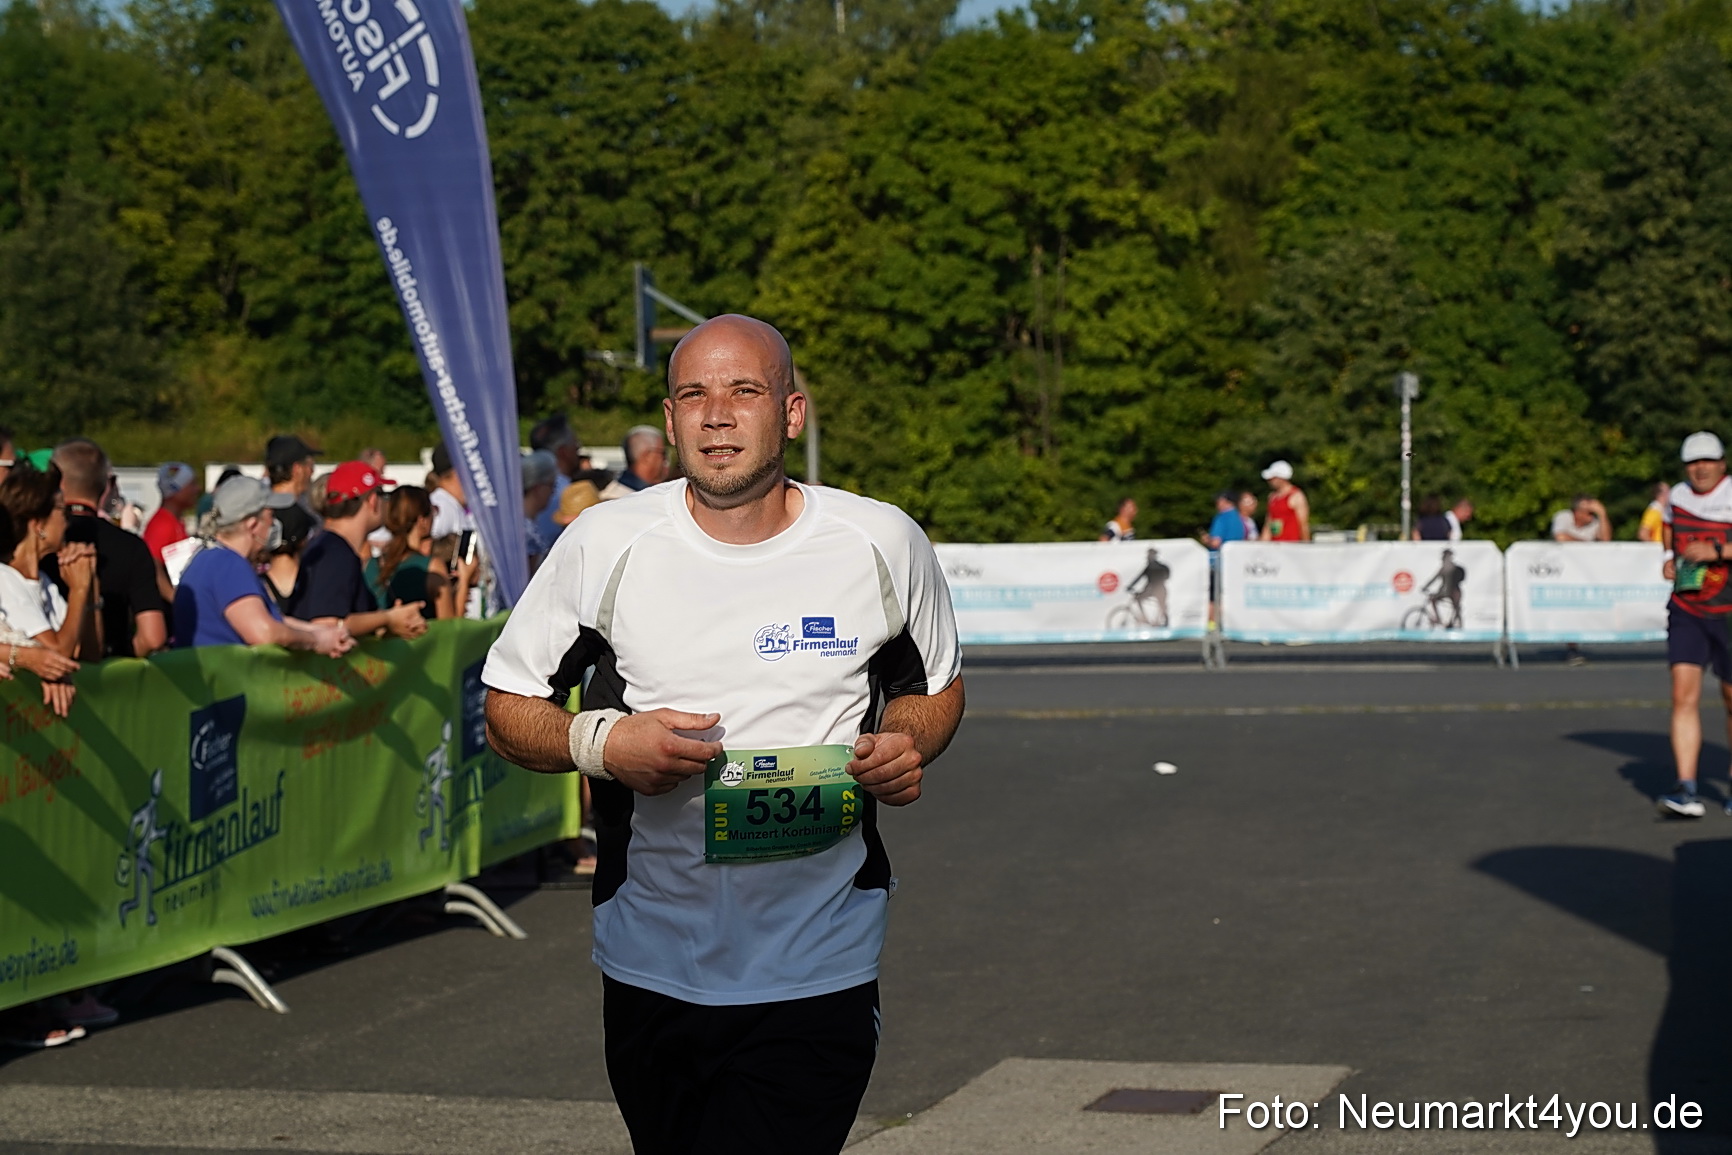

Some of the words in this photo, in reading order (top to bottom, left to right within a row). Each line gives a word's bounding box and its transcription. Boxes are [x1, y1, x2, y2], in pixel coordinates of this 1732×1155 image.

[792, 637, 858, 651] Firmenlauf
[820, 648, 857, 658] neumarkt
[746, 767, 795, 780] Firmenlauf
[765, 775, 794, 784] neumarkt
[746, 786, 825, 825] 534
[840, 789, 857, 836] 2022
[162, 771, 286, 885] firmenlauf
[714, 802, 728, 841] RUN
[729, 828, 778, 840] Munzert
[782, 824, 840, 838] Korbinian
